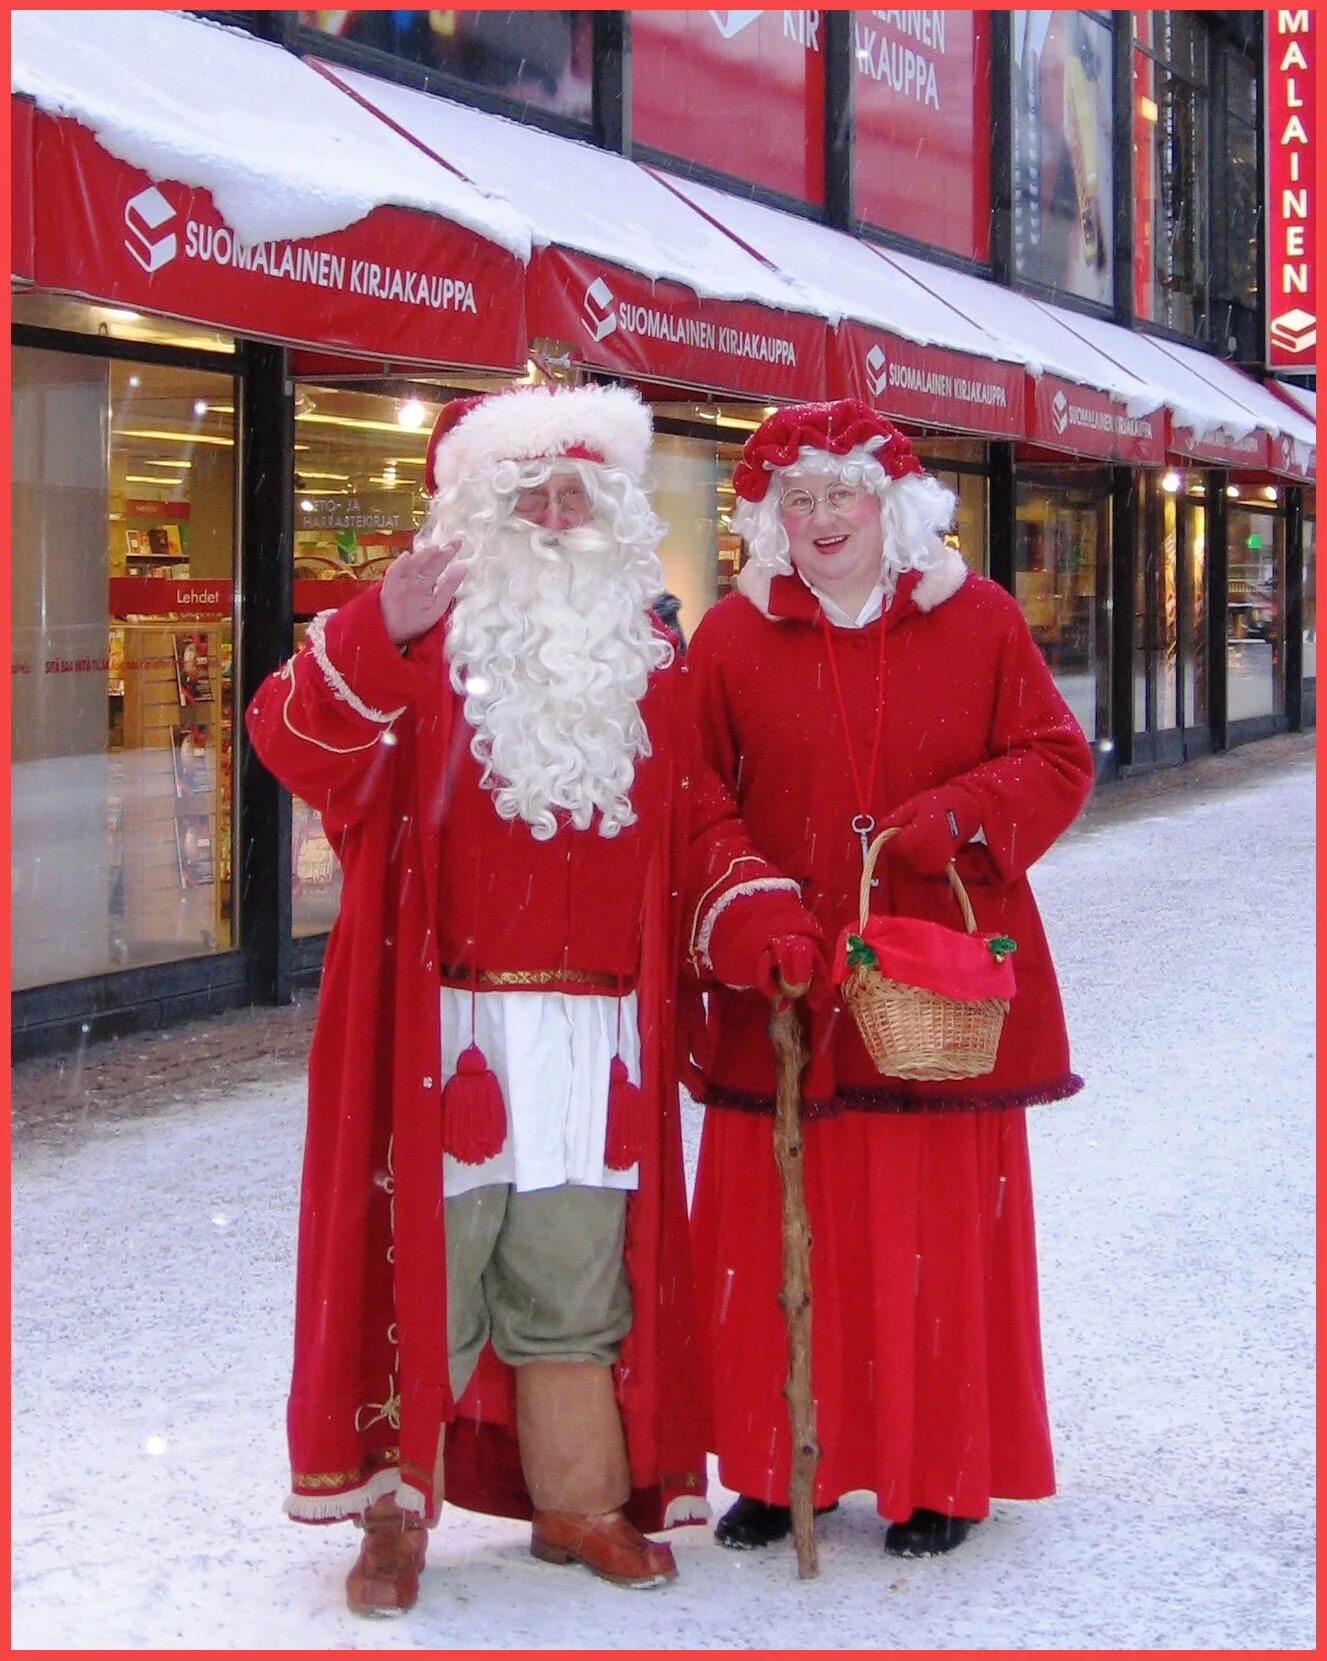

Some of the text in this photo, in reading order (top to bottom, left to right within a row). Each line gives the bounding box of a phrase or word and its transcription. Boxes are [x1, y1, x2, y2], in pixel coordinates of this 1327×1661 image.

[185, 220, 477, 314] SUOMALAINEN KIRJAKAUPPA
[619, 302, 797, 367] SUOMALAINEN KIRJAKAUPPA
[888, 362, 1007, 408] SUOMALAINEN KIRJAKAUPPA
[176, 588, 219, 604] Lehdet
